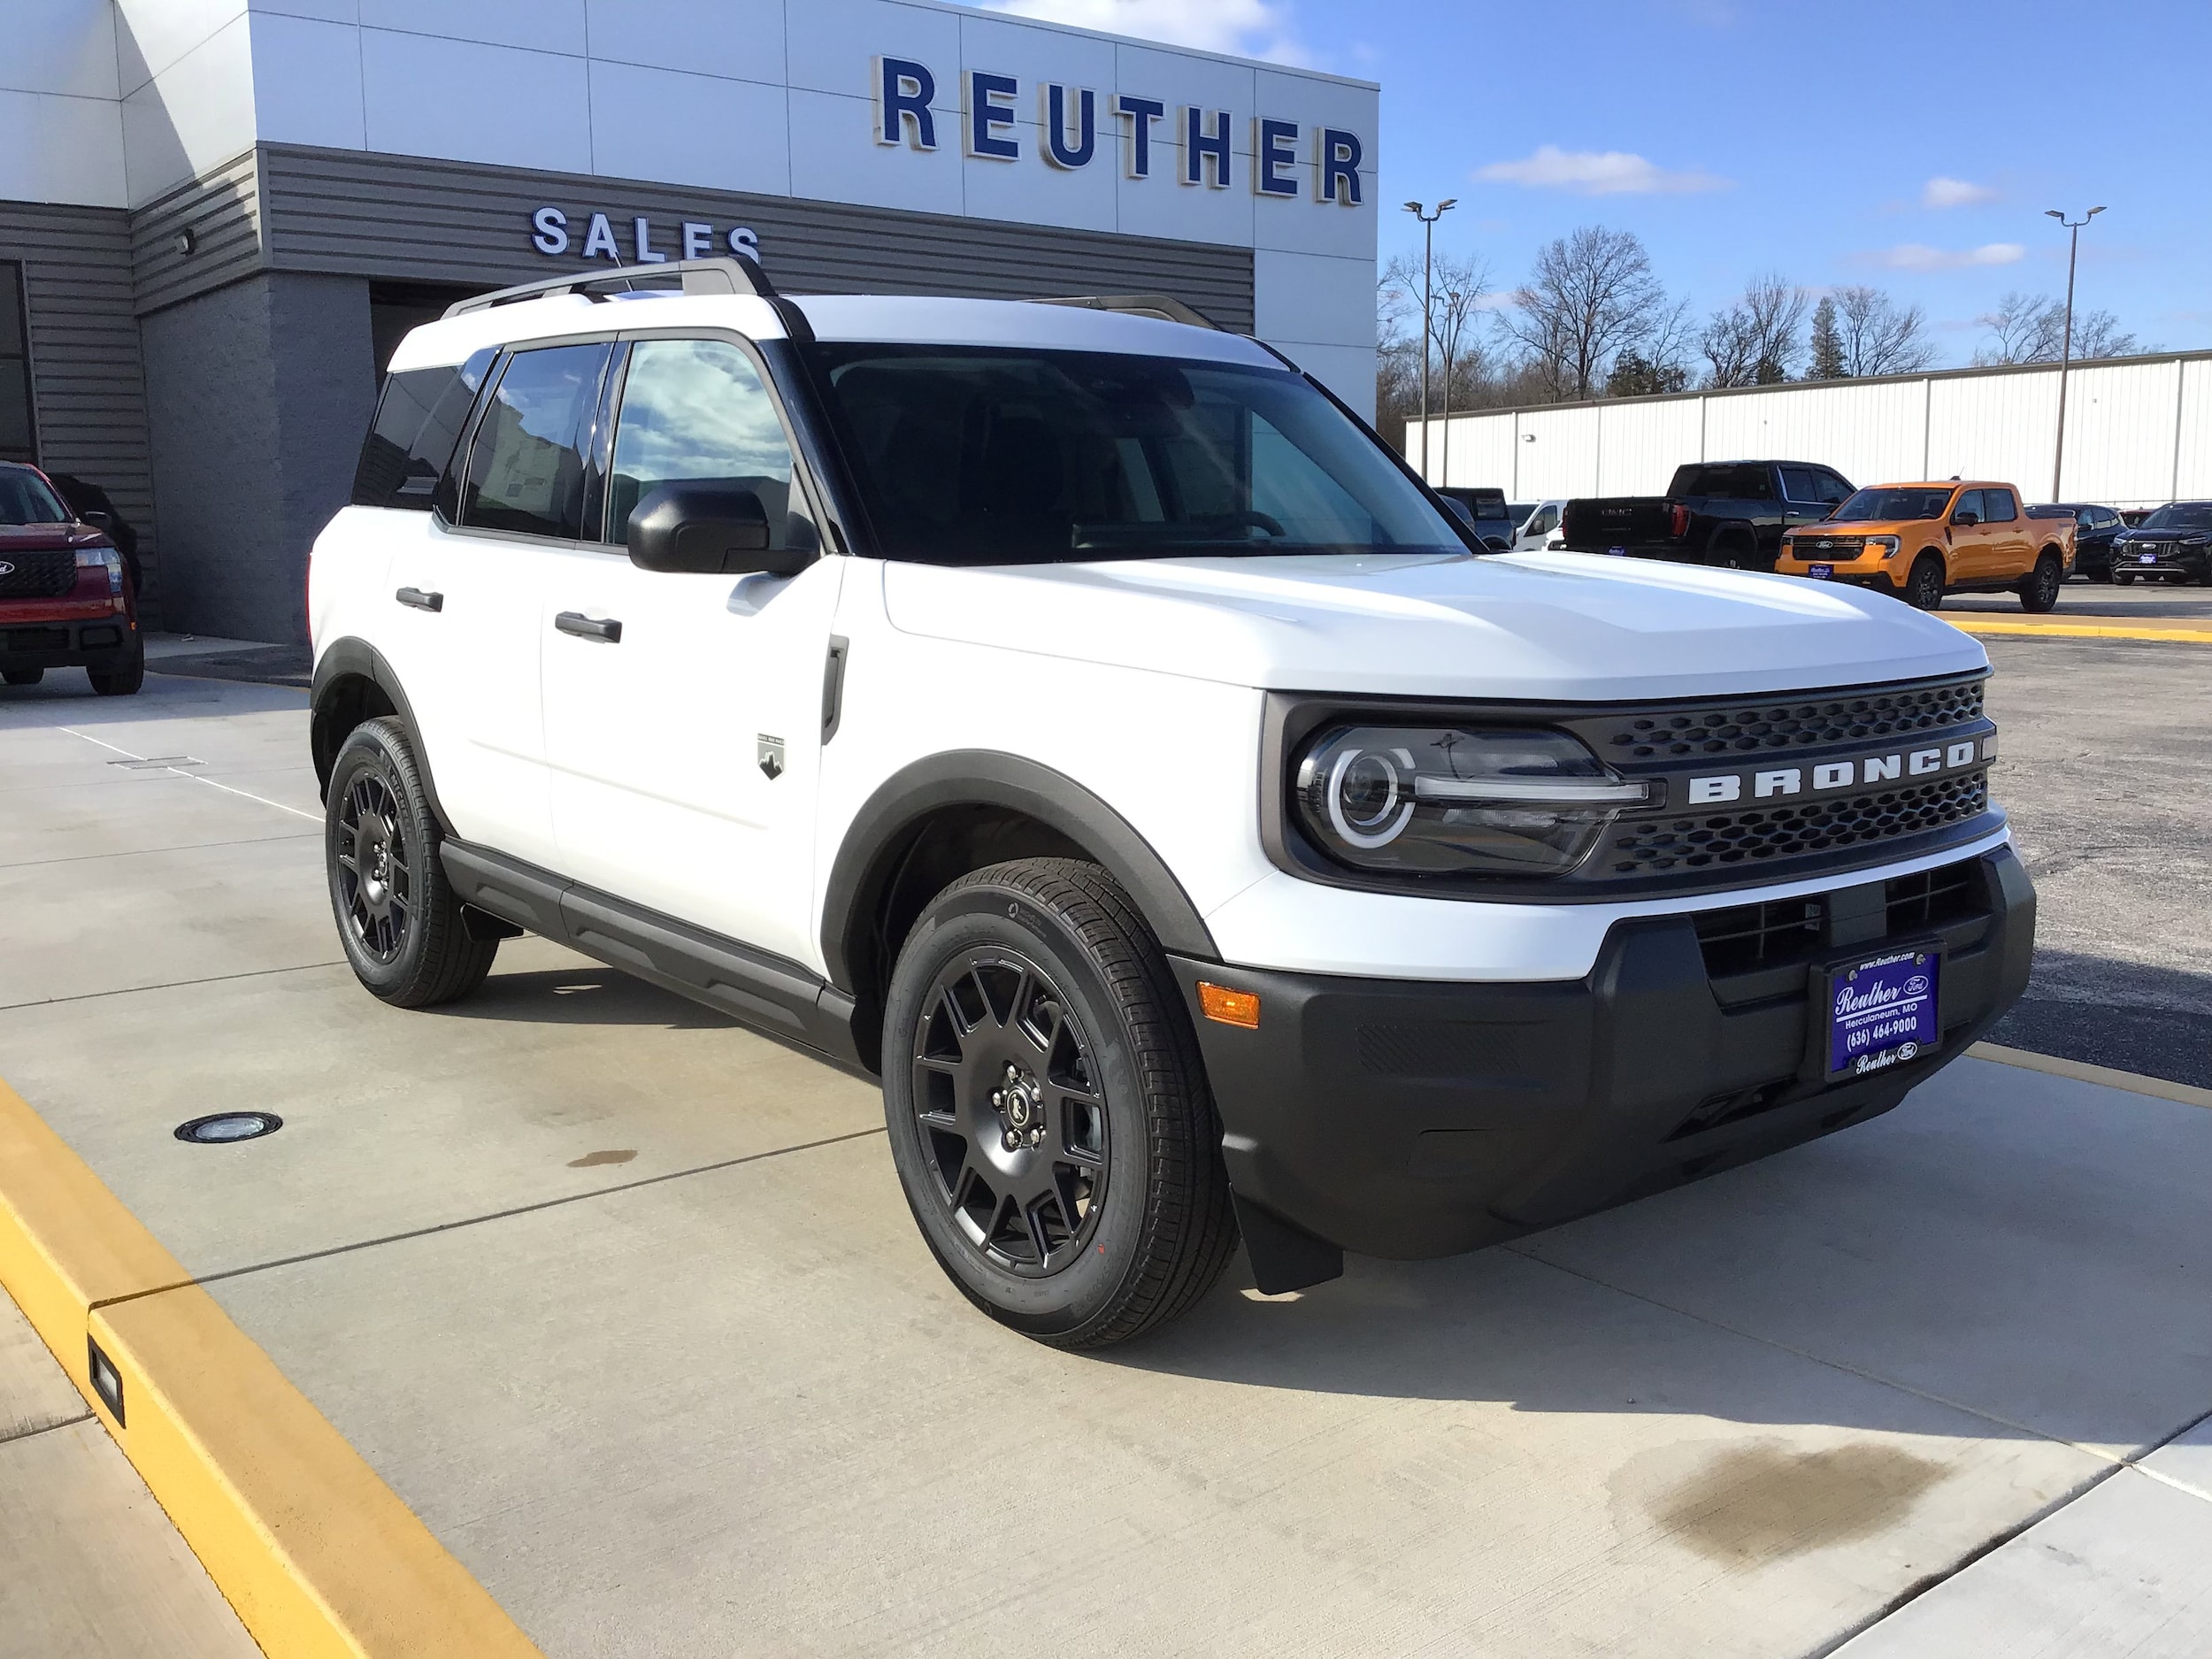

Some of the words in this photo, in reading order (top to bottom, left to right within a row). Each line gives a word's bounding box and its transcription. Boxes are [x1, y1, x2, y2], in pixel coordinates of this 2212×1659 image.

[872, 55, 1365, 207] REUTHER
[532, 206, 761, 265] SALES
[1688, 741, 1975, 805] BRONCO
[1859, 951, 1916, 972] www.Reuther.com
[1835, 980, 1902, 1016] Reuther
[1906, 977, 1926, 993] Ford
[1845, 1009, 1901, 1030] Herculaneum,
[1902, 1002, 1918, 1015] MO
[1847, 1028, 1870, 1052] (636)
[1872, 1017, 1917, 1040] 464-9000
[1856, 1049, 1897, 1074] Reuther
